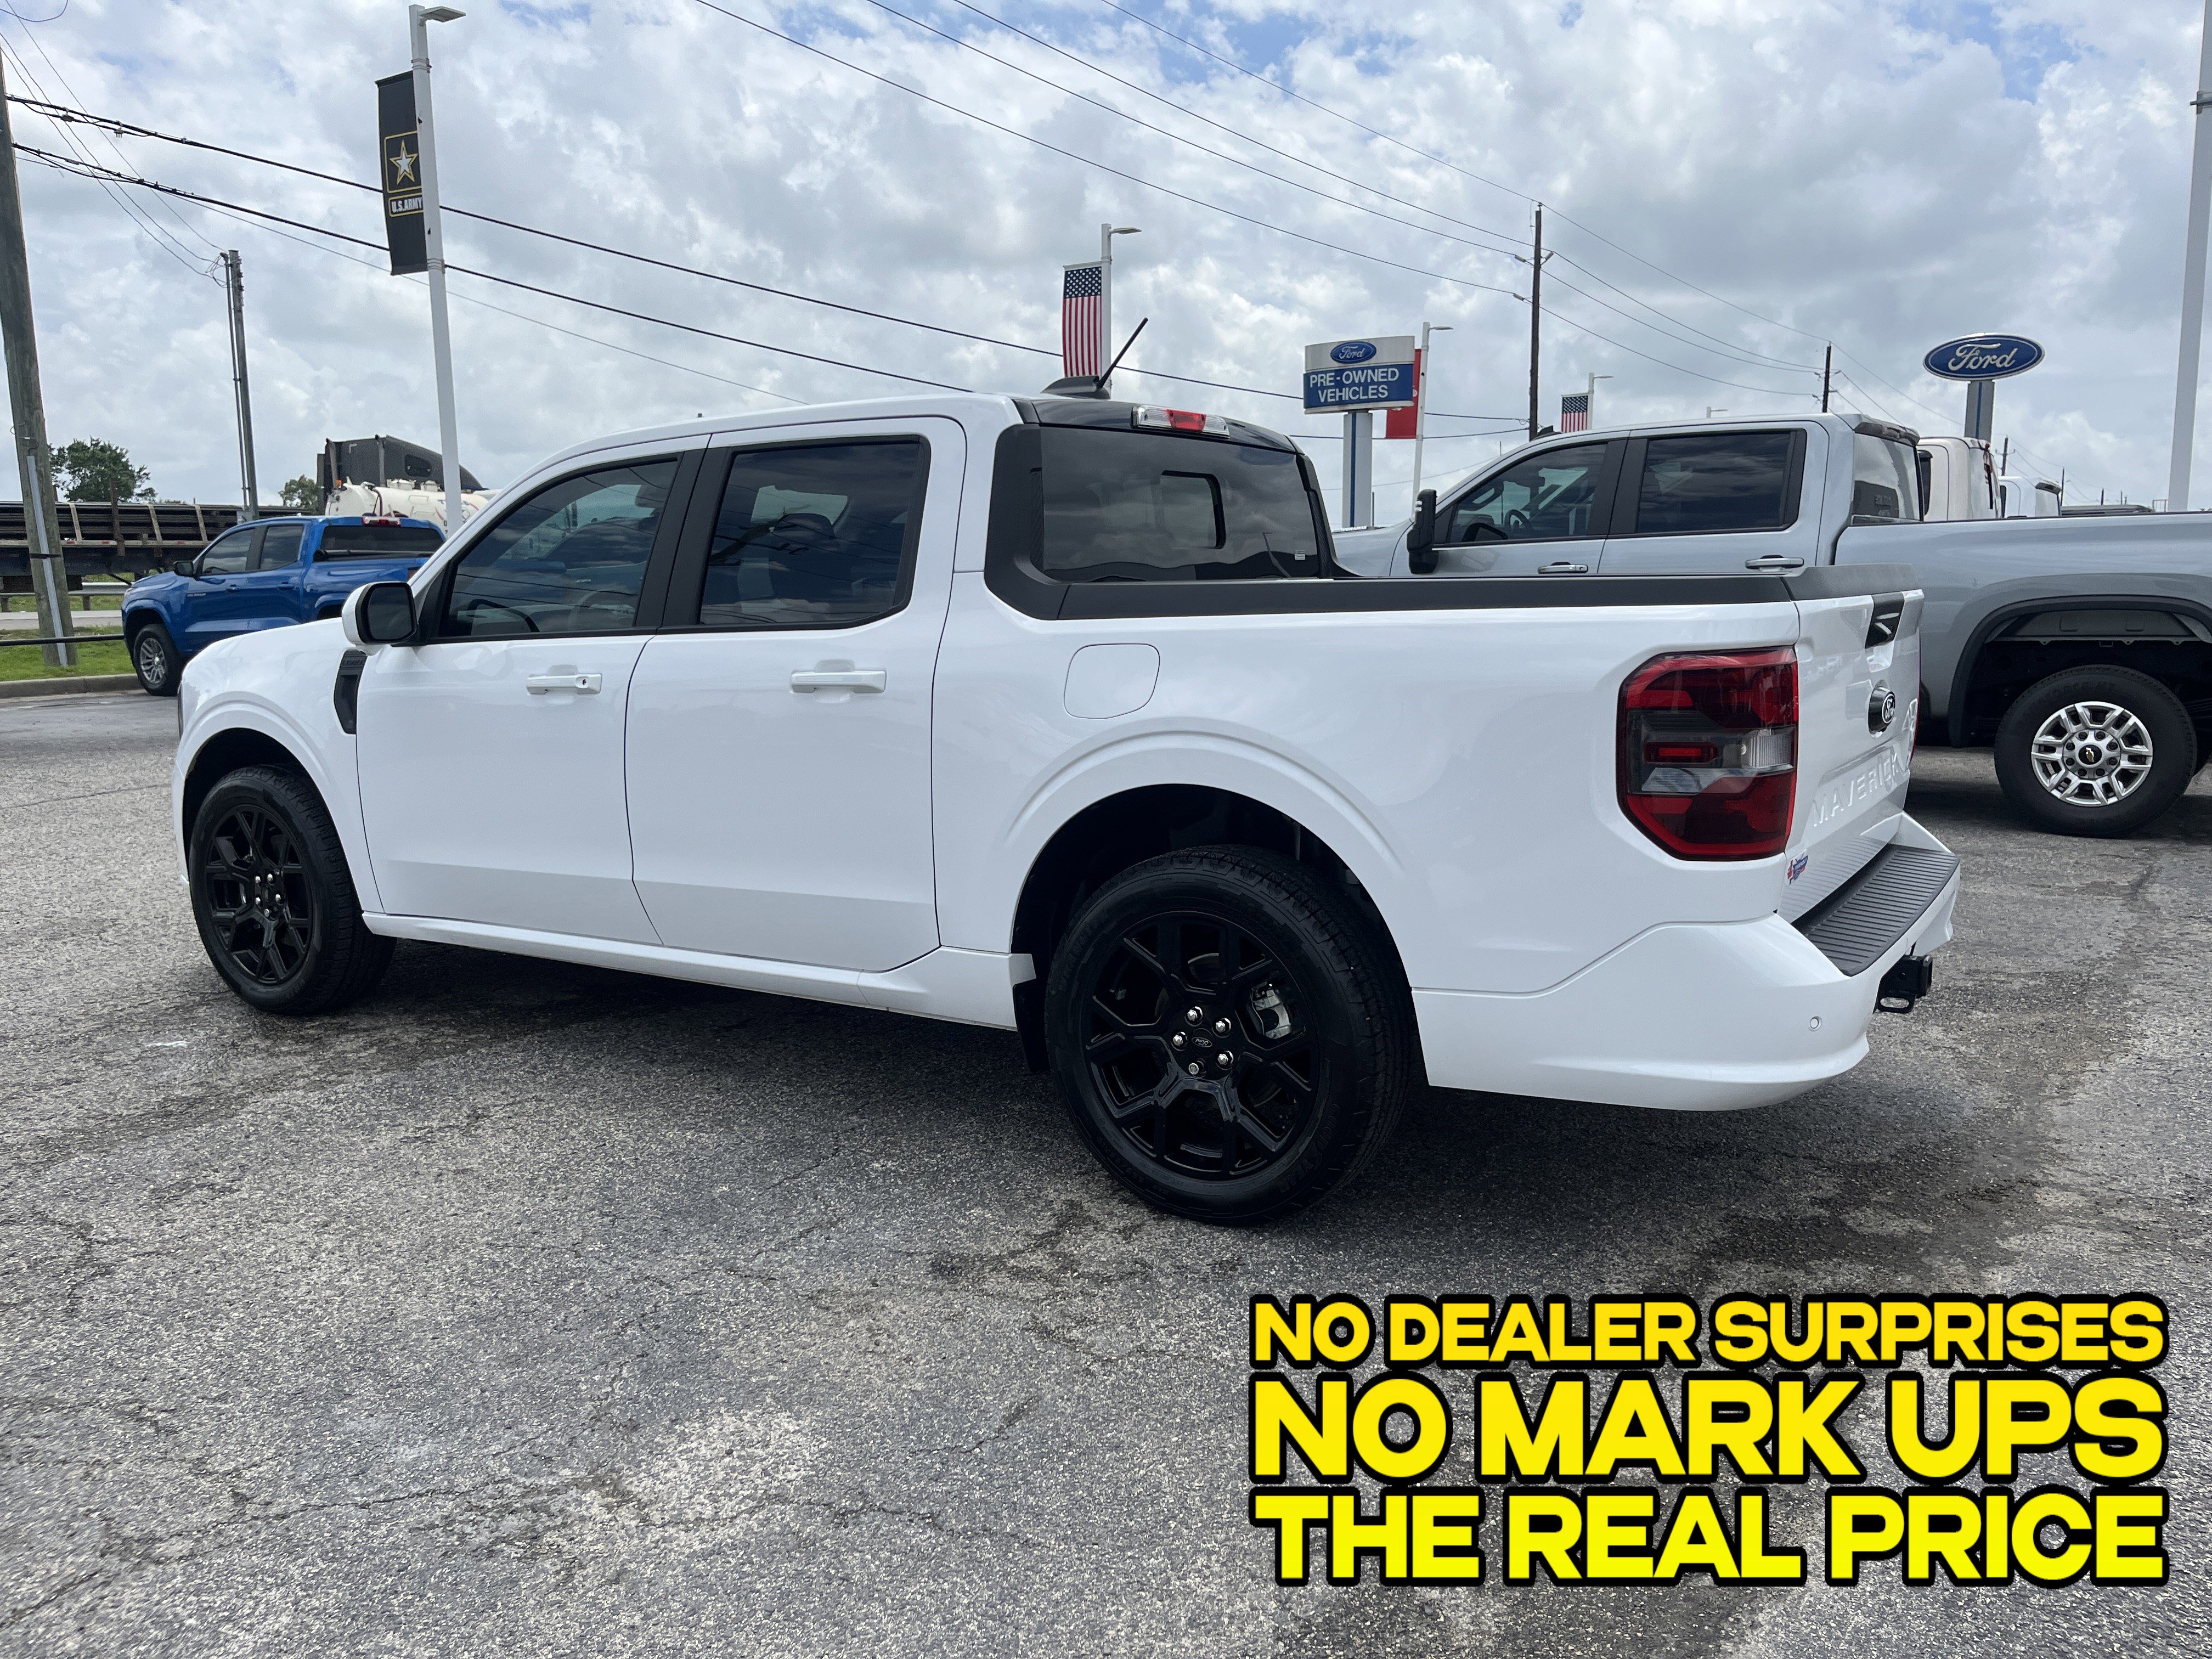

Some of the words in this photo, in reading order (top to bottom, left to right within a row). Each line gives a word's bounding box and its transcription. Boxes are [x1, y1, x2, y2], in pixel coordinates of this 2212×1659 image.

[1339, 346, 1365, 359] Ford
[1948, 343, 2018, 371] Ford
[1310, 368, 1399, 388] PRE-OWNED
[1318, 385, 1389, 403] VEHICLES
[1812, 752, 1901, 827] MAVERICK
